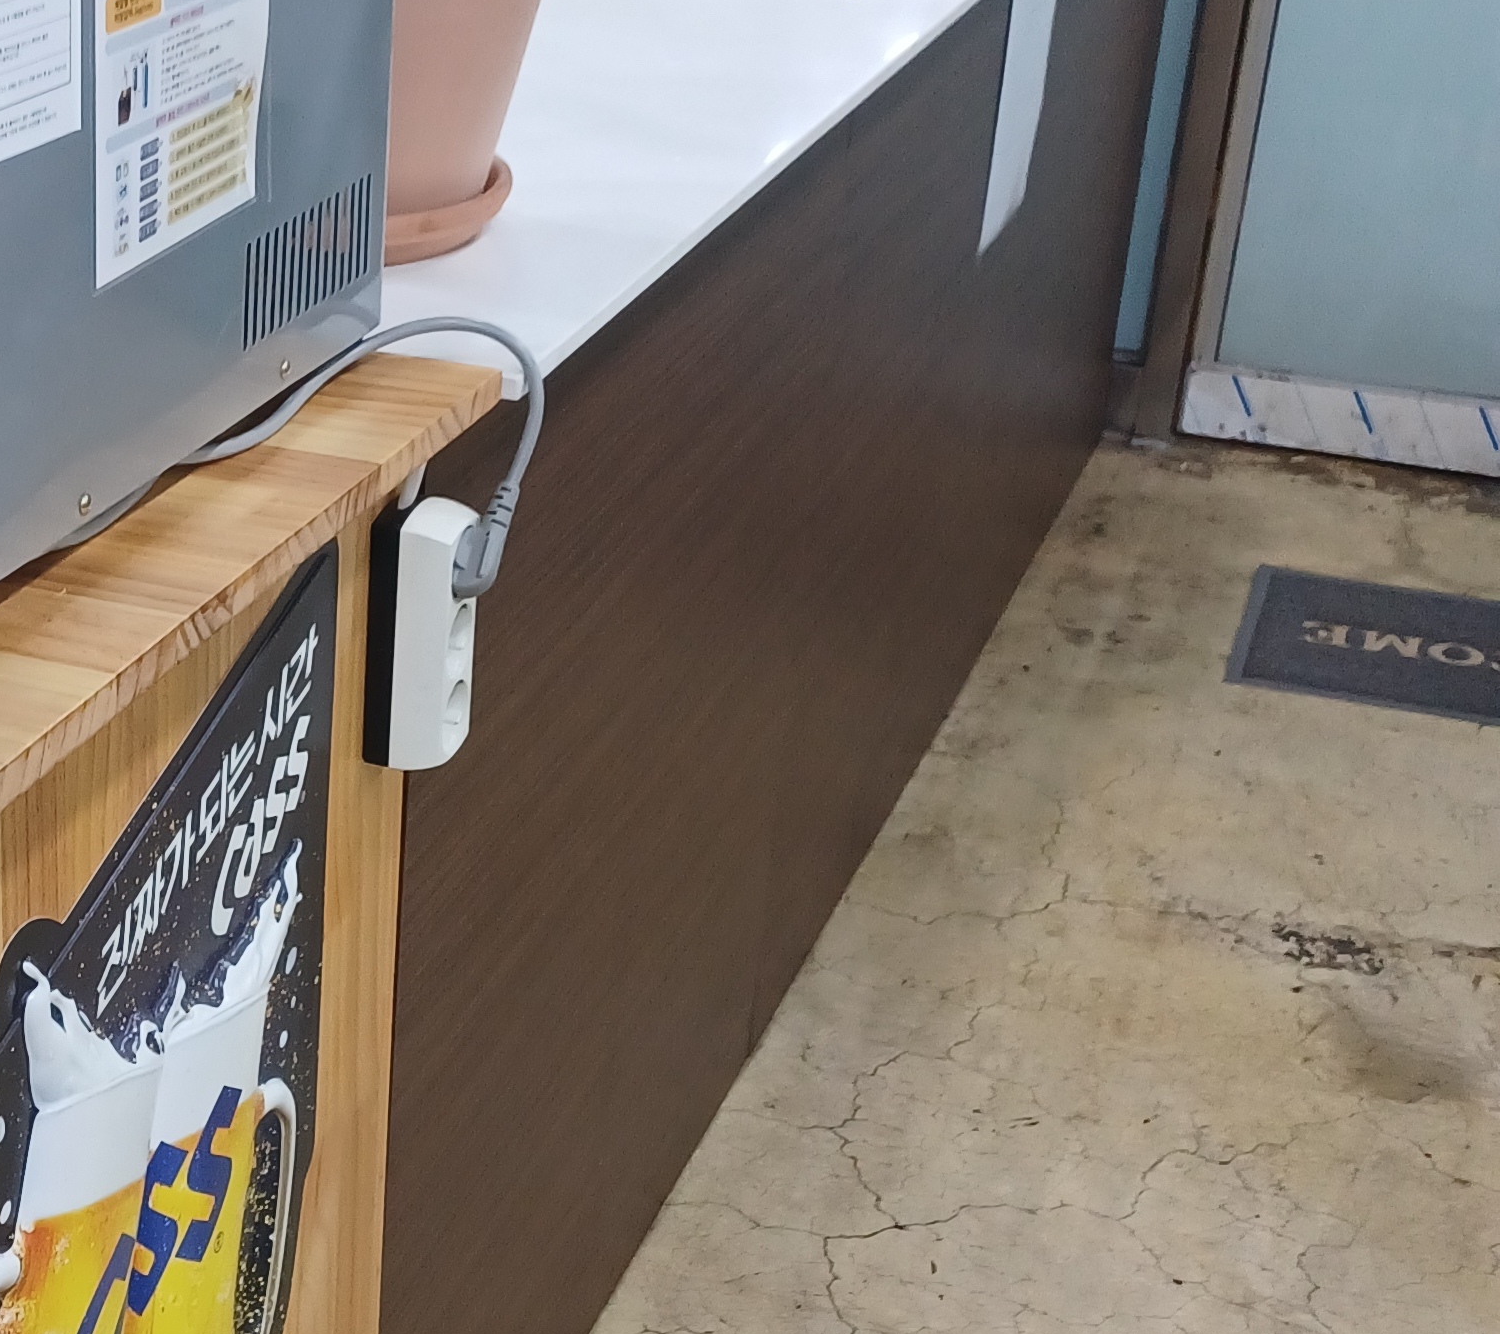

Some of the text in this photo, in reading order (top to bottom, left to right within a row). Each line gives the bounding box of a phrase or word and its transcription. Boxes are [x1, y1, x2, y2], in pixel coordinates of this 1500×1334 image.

[96, 622, 318, 1019] 진짜가 되는 시간
